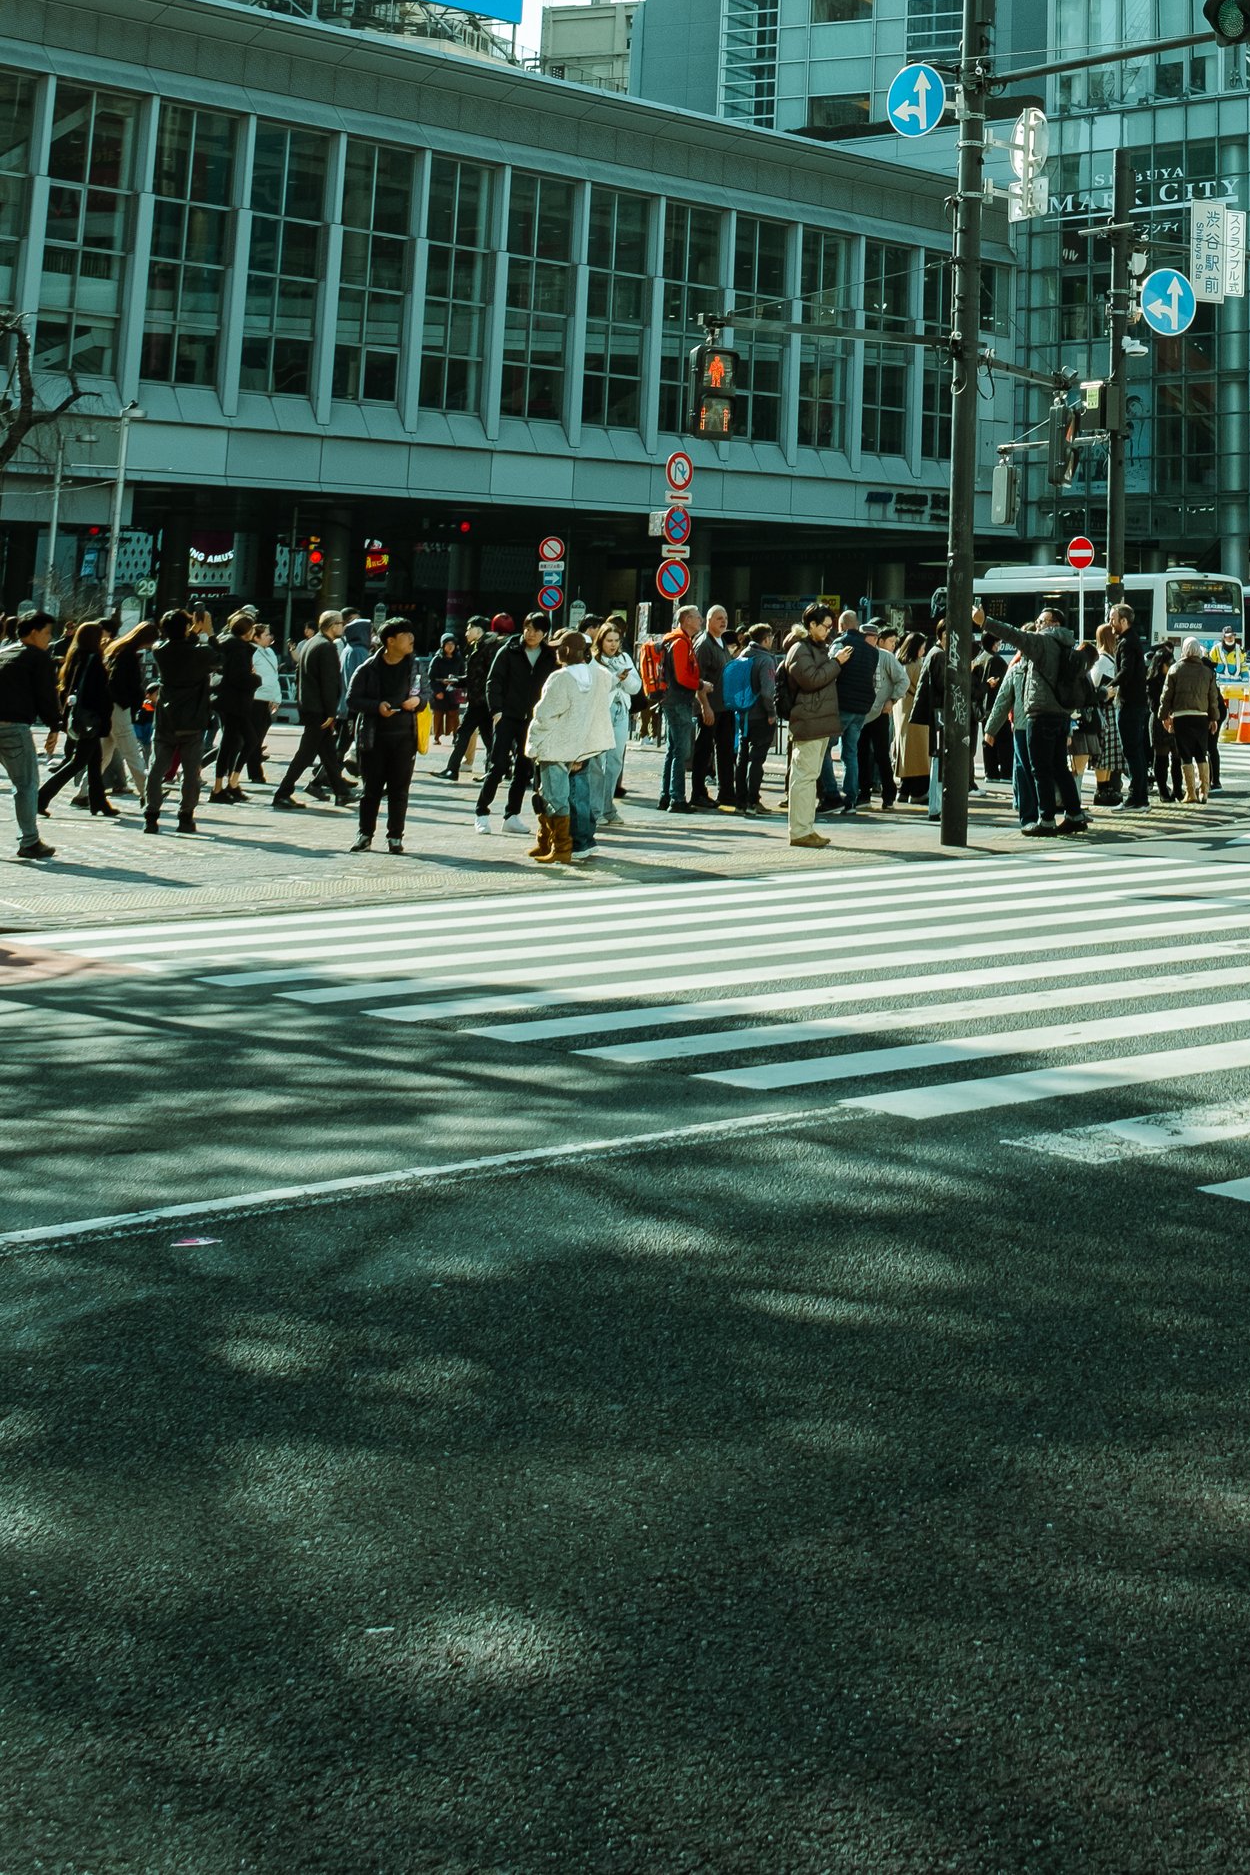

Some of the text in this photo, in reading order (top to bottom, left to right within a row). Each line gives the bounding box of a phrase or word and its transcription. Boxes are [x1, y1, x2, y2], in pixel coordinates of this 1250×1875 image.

[1094, 167, 1184, 187] SBUYA
[1159, 178, 1240, 202] CITY
[1195, 222, 1205, 260] Shibuya
[1204, 210, 1221, 294] 渋谷駅前
[206, 549, 235, 564] AMUS
[138, 579, 156, 595] 29
